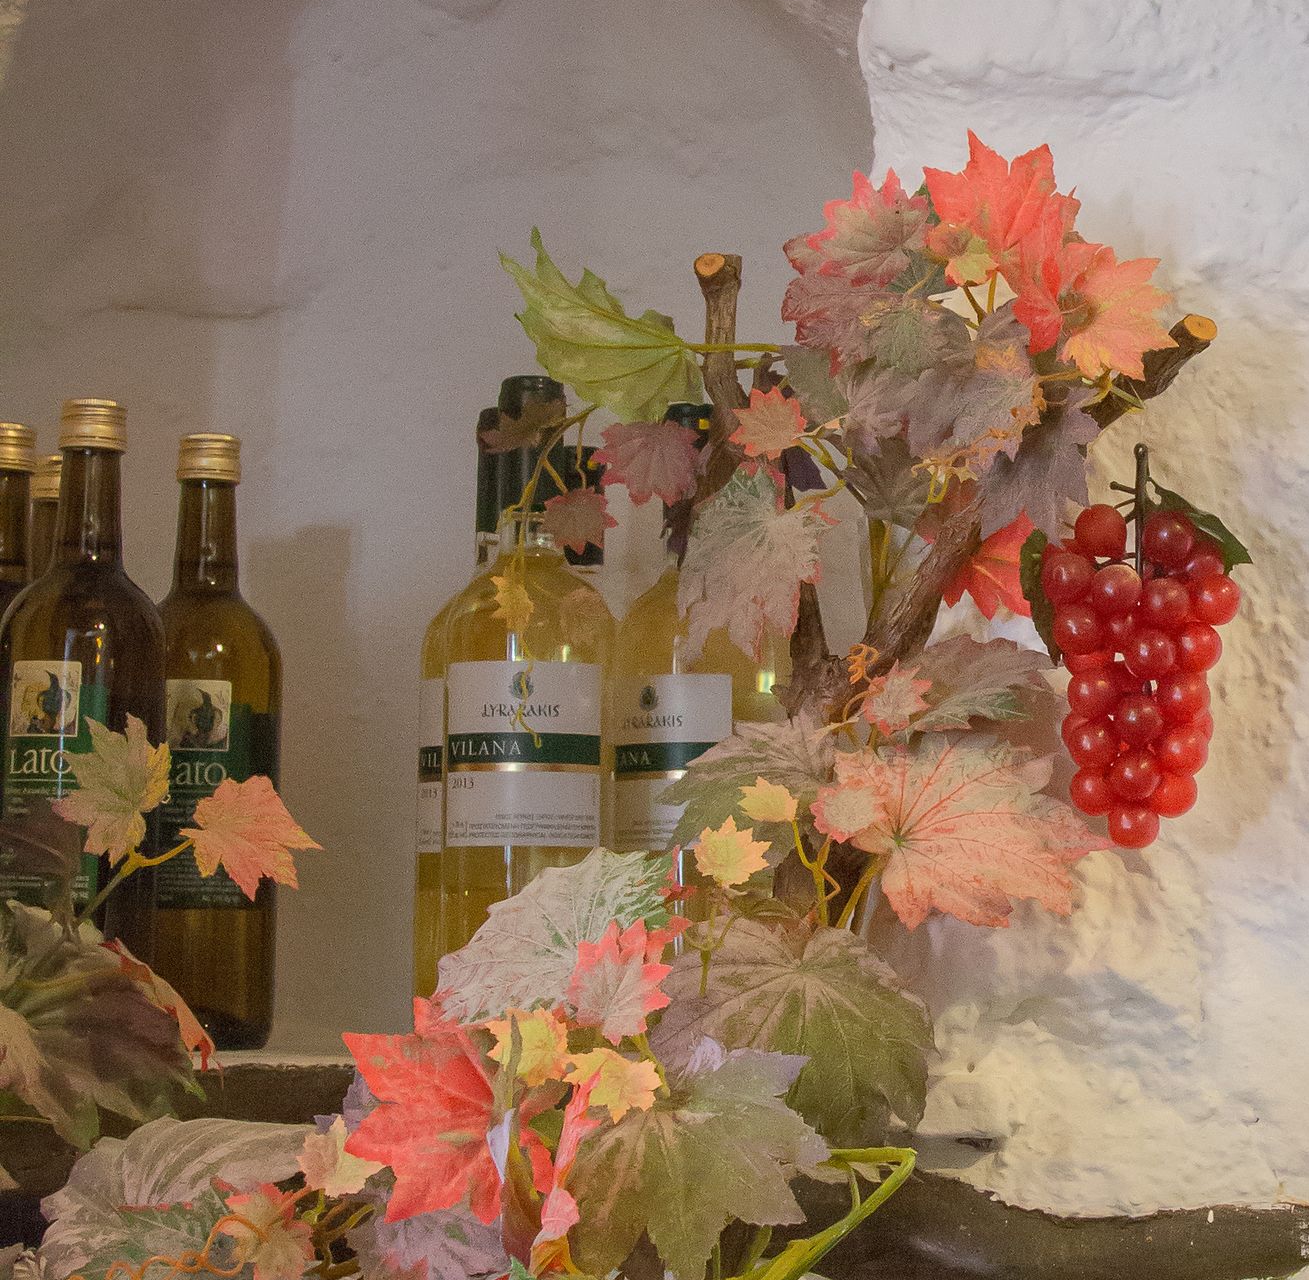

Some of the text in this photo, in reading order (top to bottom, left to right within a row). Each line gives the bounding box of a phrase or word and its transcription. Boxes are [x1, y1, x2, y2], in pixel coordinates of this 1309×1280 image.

[451, 739, 522, 756] VILANA
[9, 747, 72, 775] Lato
[169, 761, 227, 786] ato
[452, 777, 474, 789] 2013
